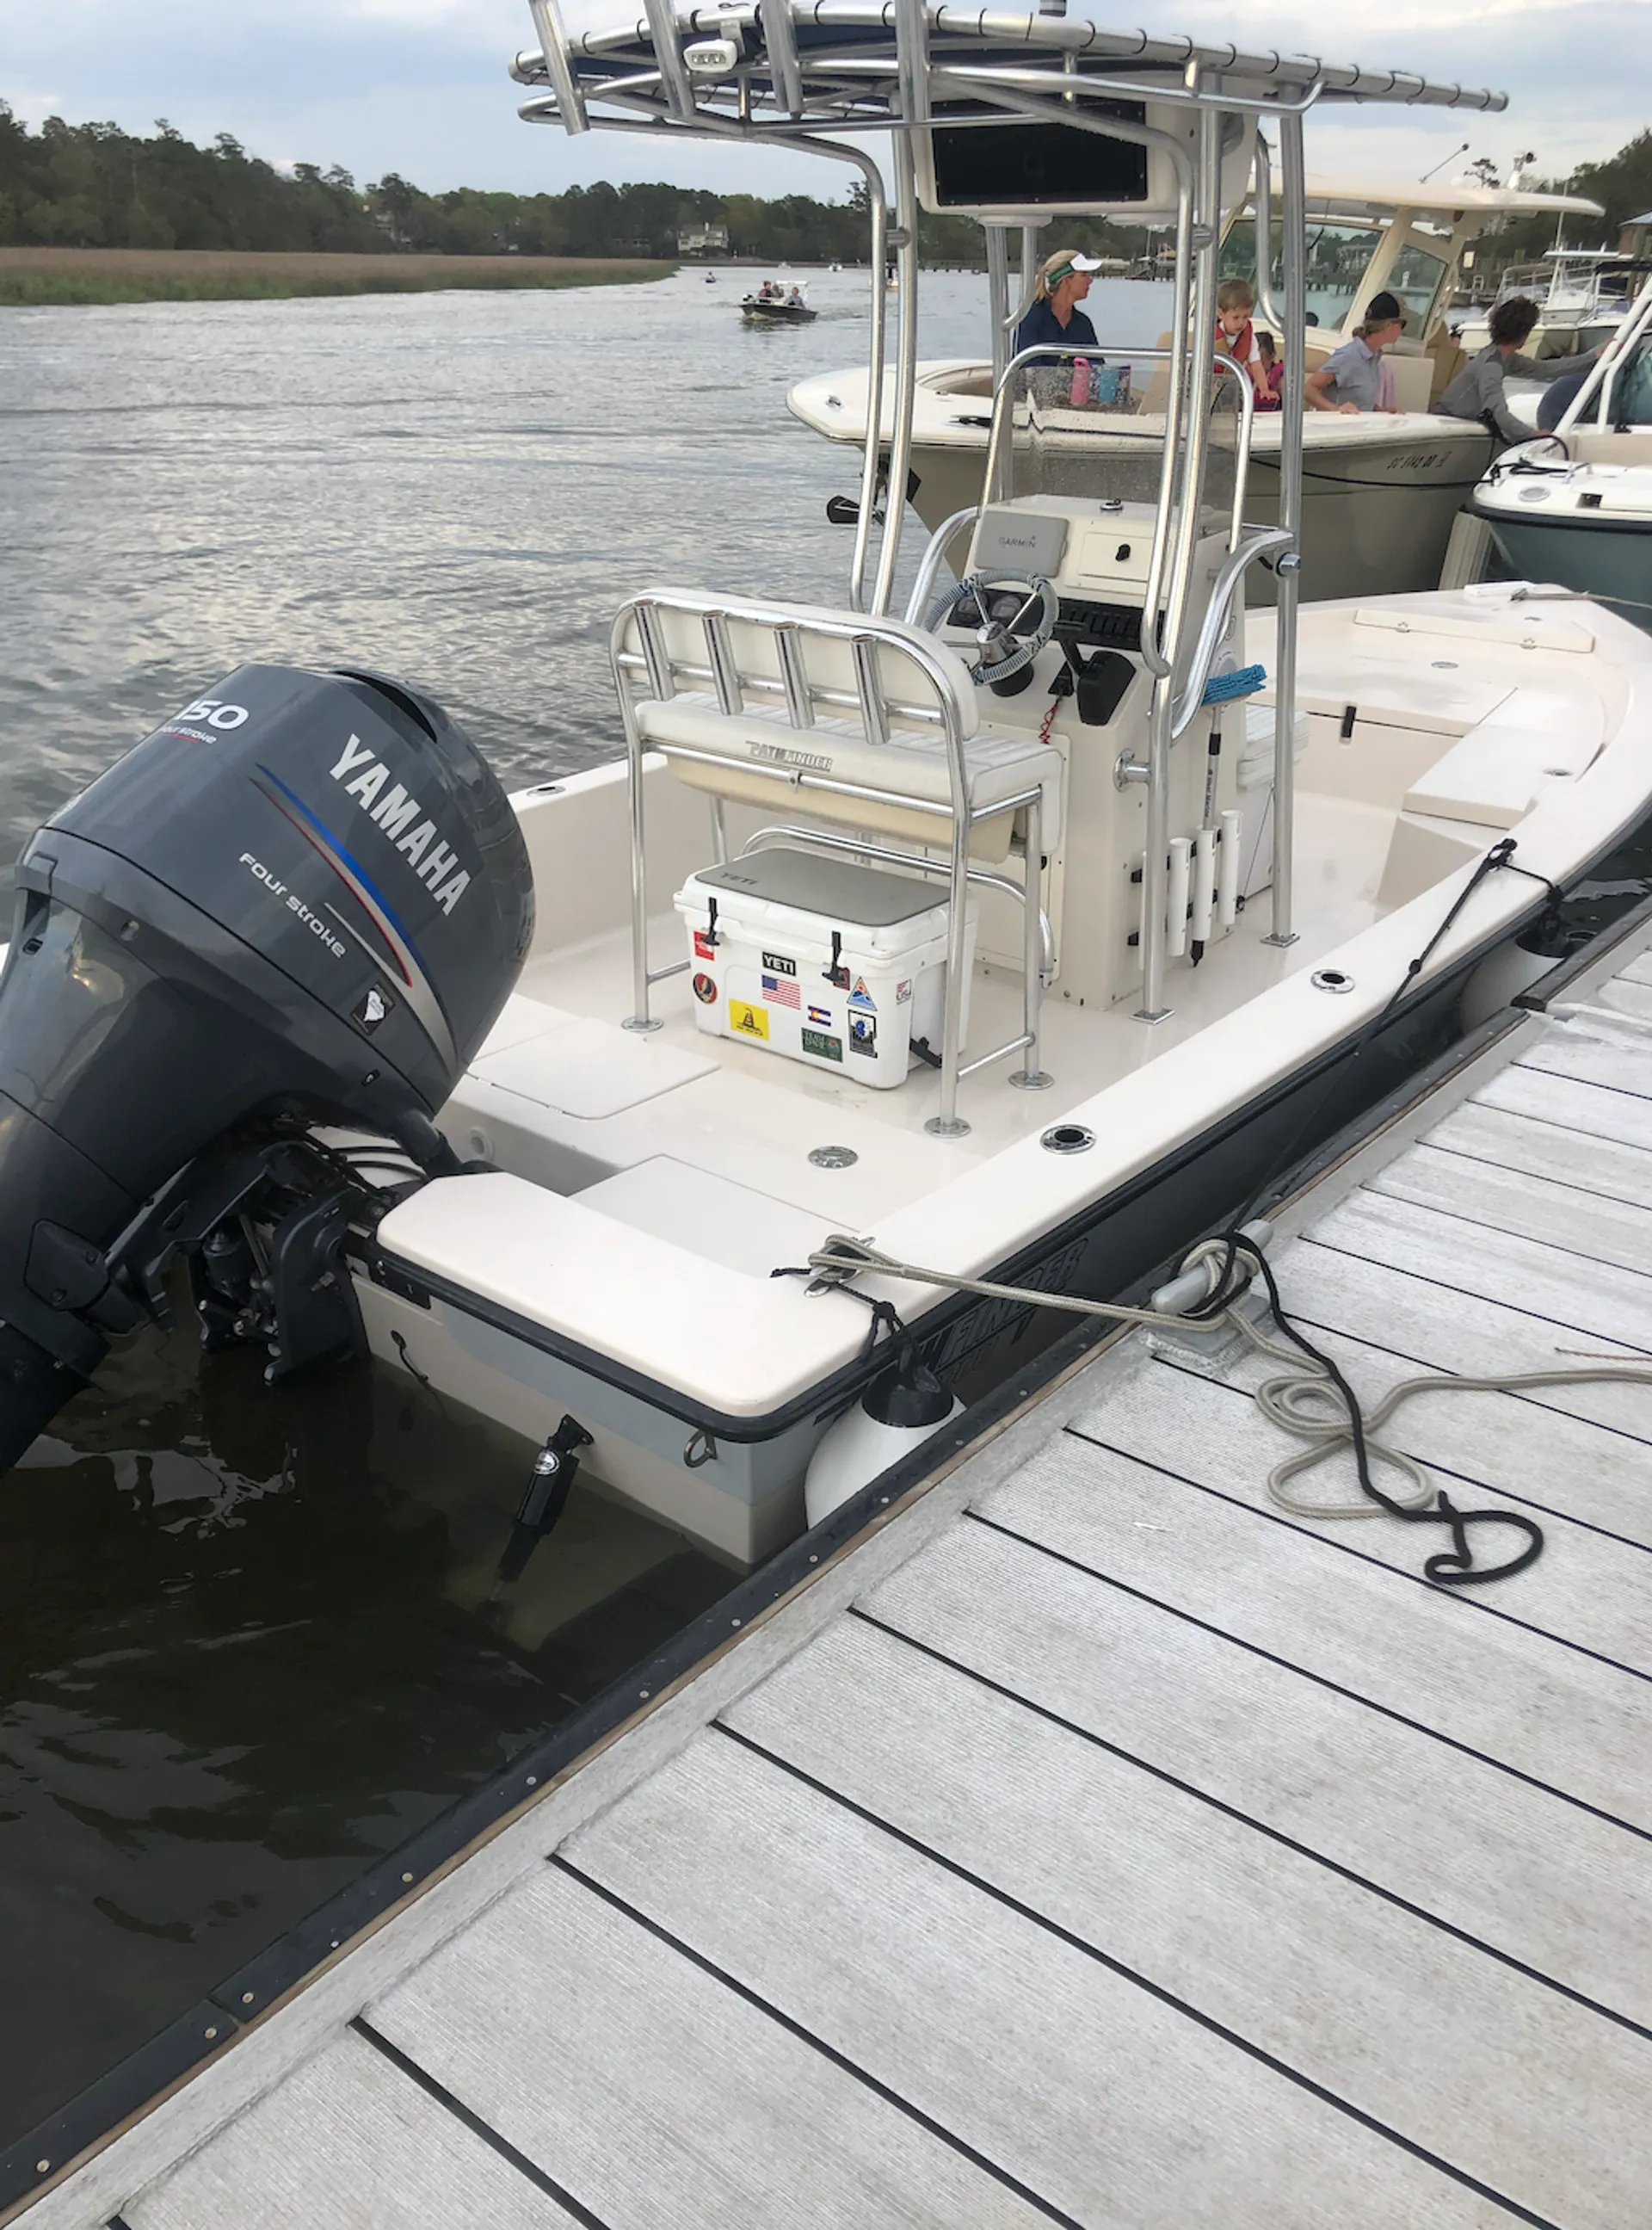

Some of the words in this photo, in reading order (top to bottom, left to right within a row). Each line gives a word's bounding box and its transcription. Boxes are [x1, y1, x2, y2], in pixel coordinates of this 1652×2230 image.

[999, 536, 1035, 548] GARMIN
[173, 700, 250, 731] 150
[329, 733, 472, 916] YAMAHA
[721, 872, 758, 886] YETI
[764, 954, 794, 973] YETI
